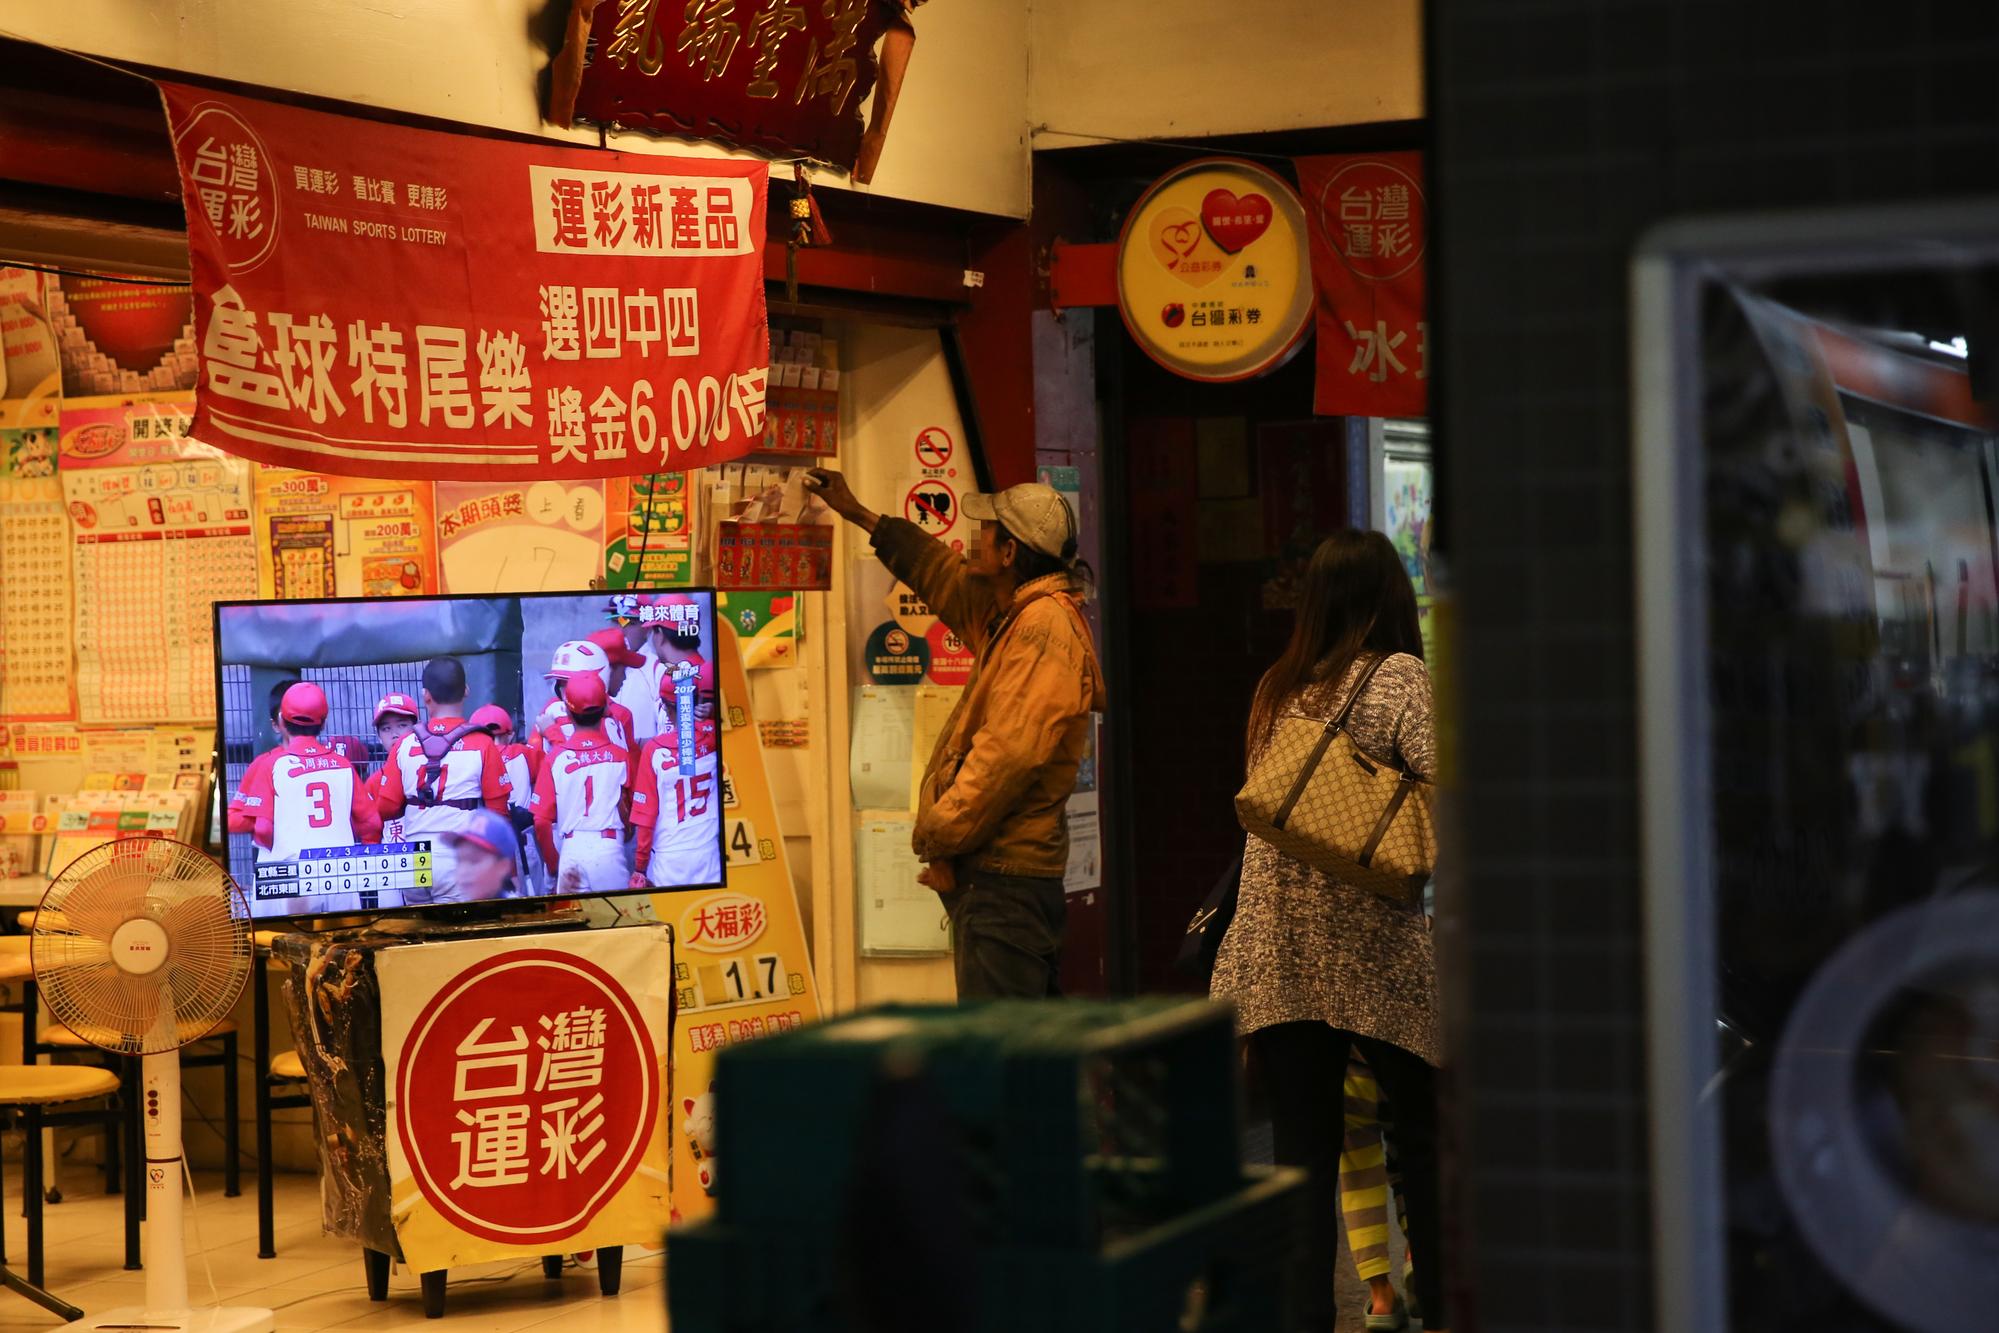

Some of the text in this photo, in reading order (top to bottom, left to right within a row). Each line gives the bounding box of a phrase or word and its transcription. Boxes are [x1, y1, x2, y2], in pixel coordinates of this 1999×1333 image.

[191, 137, 259, 192] 台灣
[293, 165, 448, 211] 買運彩 看比賽 更精彩
[1340, 184, 1410, 221] 台灣
[303, 213, 447, 247] TAIWAN SPORTS LOTTERY
[550, 177, 740, 250] 運彩新產品
[1343, 222, 1413, 258] 運彩
[539, 284, 700, 361] 選四中四
[1192, 307, 1262, 326] 台灣彩券
[639, 604, 700, 622] 緯來體育
[900, 606, 932, 616] 助人又
[678, 624, 700, 637] HD
[673, 685, 697, 695] 2017
[305, 782, 332, 828] 3
[584, 775, 593, 817] 1
[674, 772, 713, 824] 15
[305, 864, 312, 874] 0
[324, 862, 331, 873] 0
[343, 861, 350, 872] 0
[381, 858, 388, 869] 0
[400, 857, 407, 868] 8
[419, 856, 426, 866] 9
[326, 849, 331, 857] 2
[345, 848, 351, 856] 3
[364, 846, 370, 854] 4
[383, 845, 388, 853] 5
[401, 843, 407, 852] 6
[419, 843, 426, 851] R
[305, 881, 312, 892] 2
[325, 880, 332, 890] 0
[344, 879, 351, 889] 0
[363, 877, 370, 888] 2
[382, 876, 389, 886] 2
[420, 873, 427, 884] 6
[687, 902, 763, 944] 大福彩
[726, 957, 778, 999] 1.7
[453, 1004, 608, 1102] 台灣
[688, 1022, 726, 1052] 買彩券
[449, 1091, 608, 1191] 運彩
